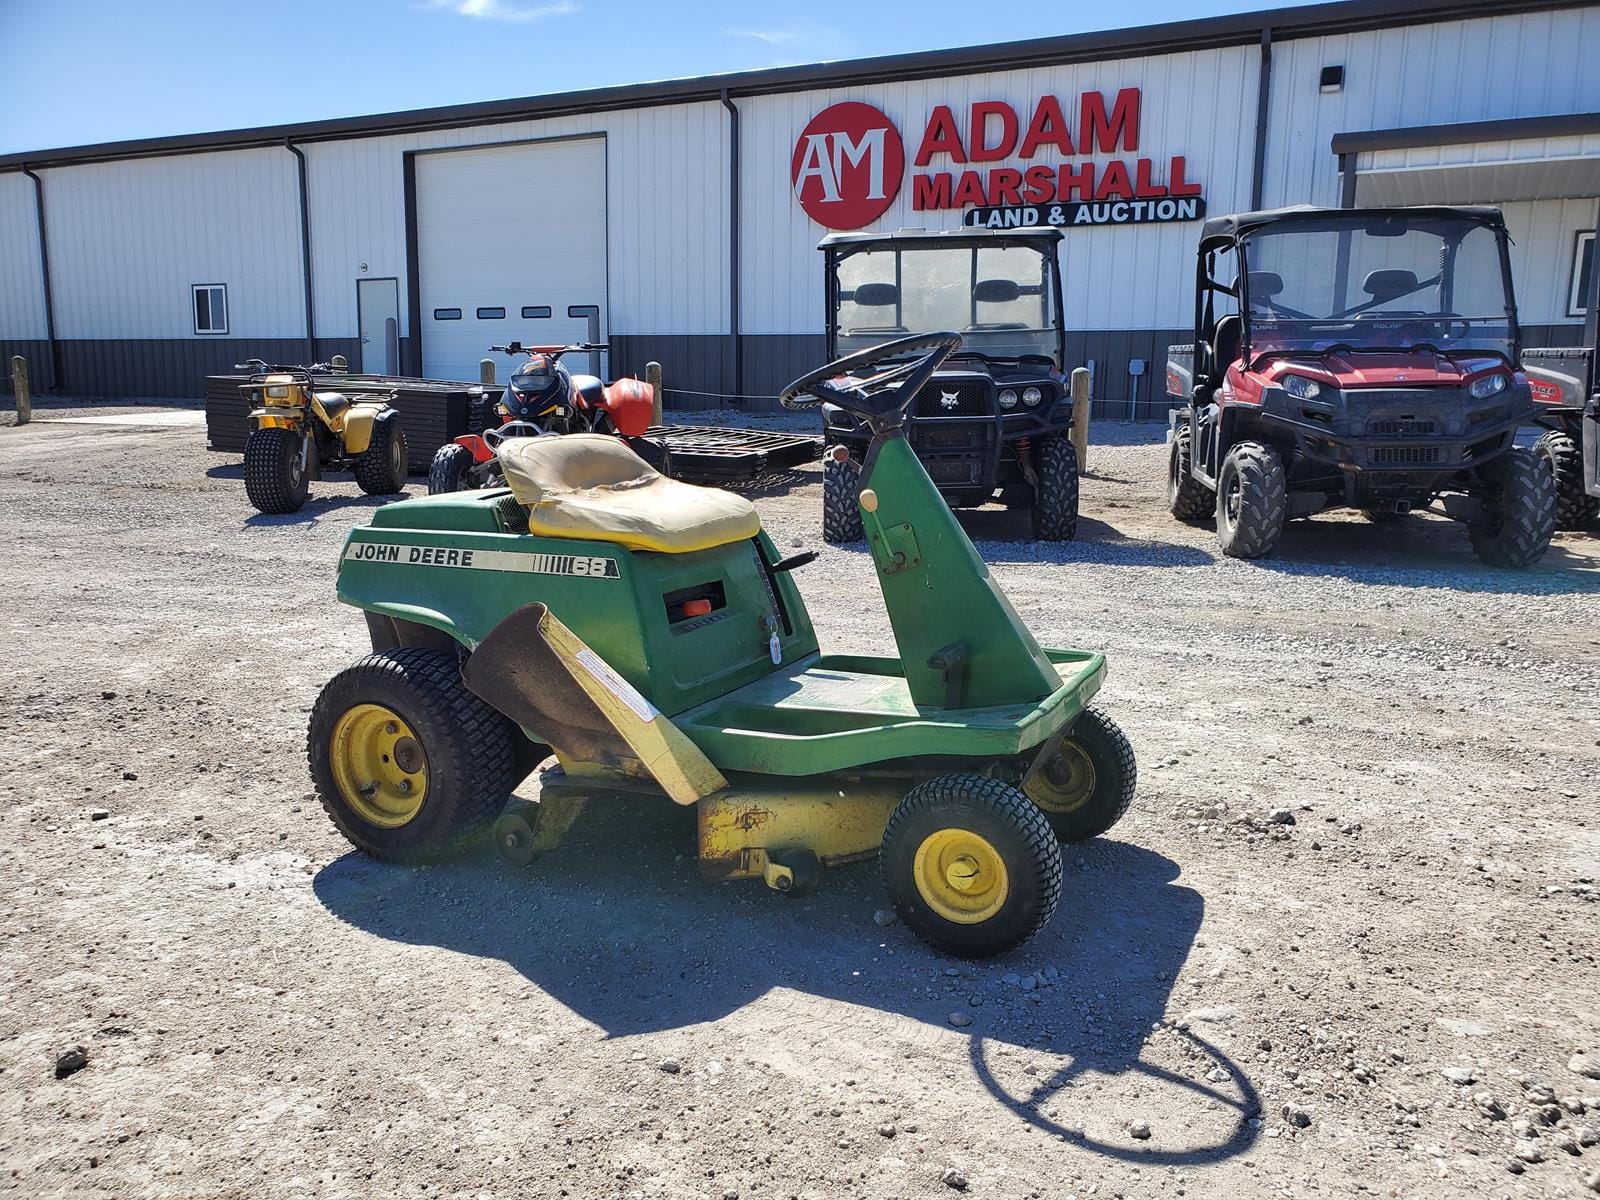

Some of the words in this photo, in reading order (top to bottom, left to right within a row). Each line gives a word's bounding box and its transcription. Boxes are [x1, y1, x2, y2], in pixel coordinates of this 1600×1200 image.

[914, 87, 1142, 166] ADAM
[796, 128, 889, 203] AM
[913, 156, 1201, 211] MARSHALL
[973, 208, 1038, 228] LAND
[1047, 206, 1066, 224] &
[1074, 199, 1197, 223] AUCTION
[355, 544, 400, 561] JOHN
[409, 547, 474, 567] DEERE
[572, 558, 607, 576] 68
